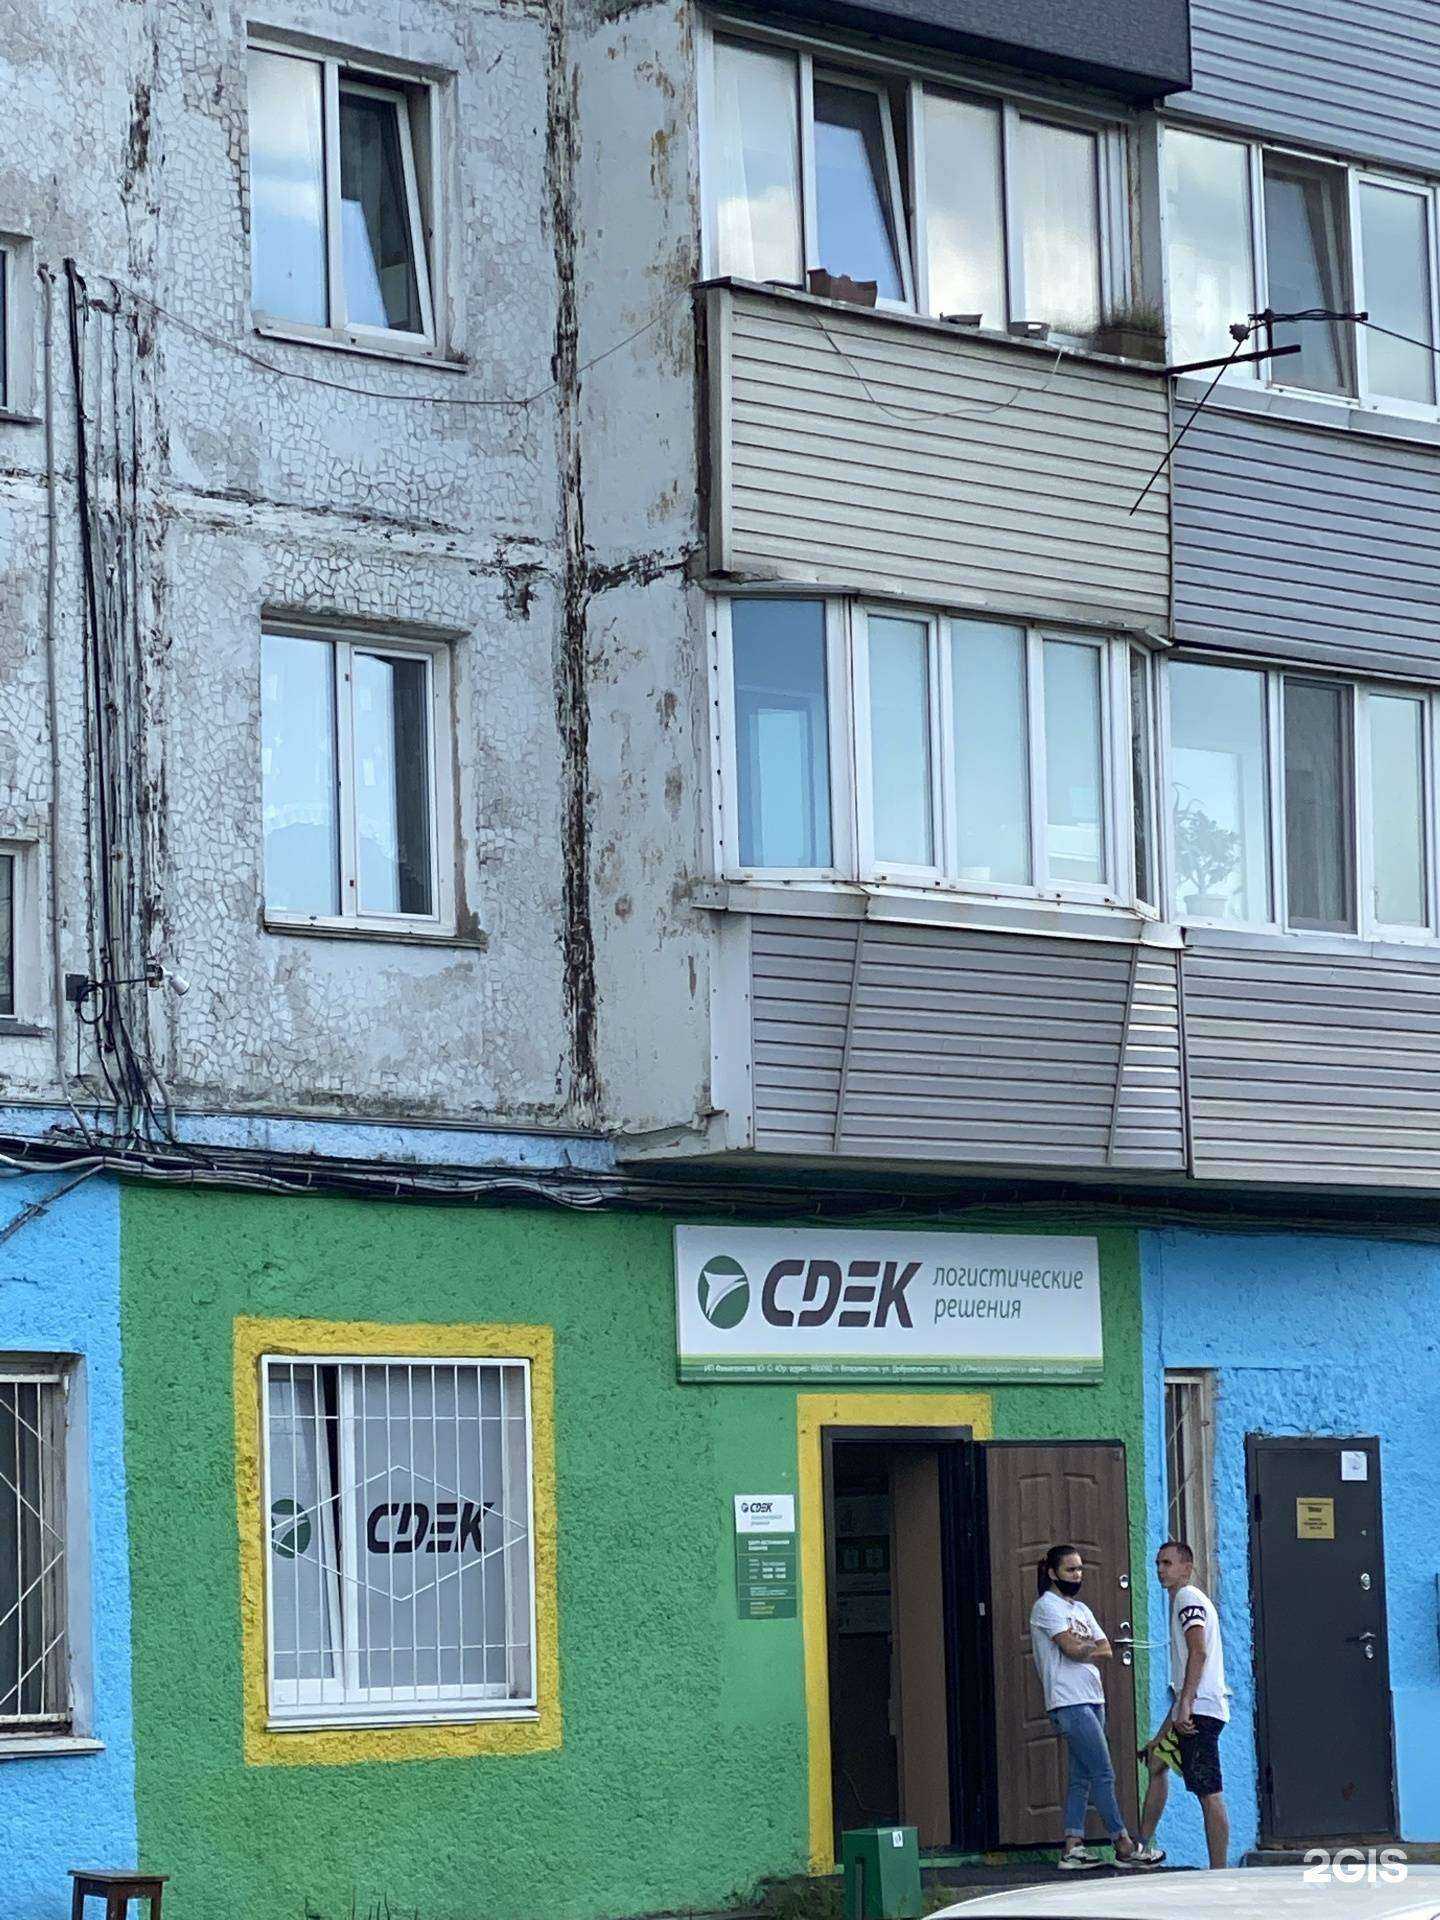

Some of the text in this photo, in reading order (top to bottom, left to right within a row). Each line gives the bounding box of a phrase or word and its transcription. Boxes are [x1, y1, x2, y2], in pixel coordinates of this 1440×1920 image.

[761, 1258, 923, 1329] CDEK
[932, 1265, 1084, 1291] логистические
[933, 1297, 1021, 1324] решения
[366, 1502, 495, 1554] CDEK
